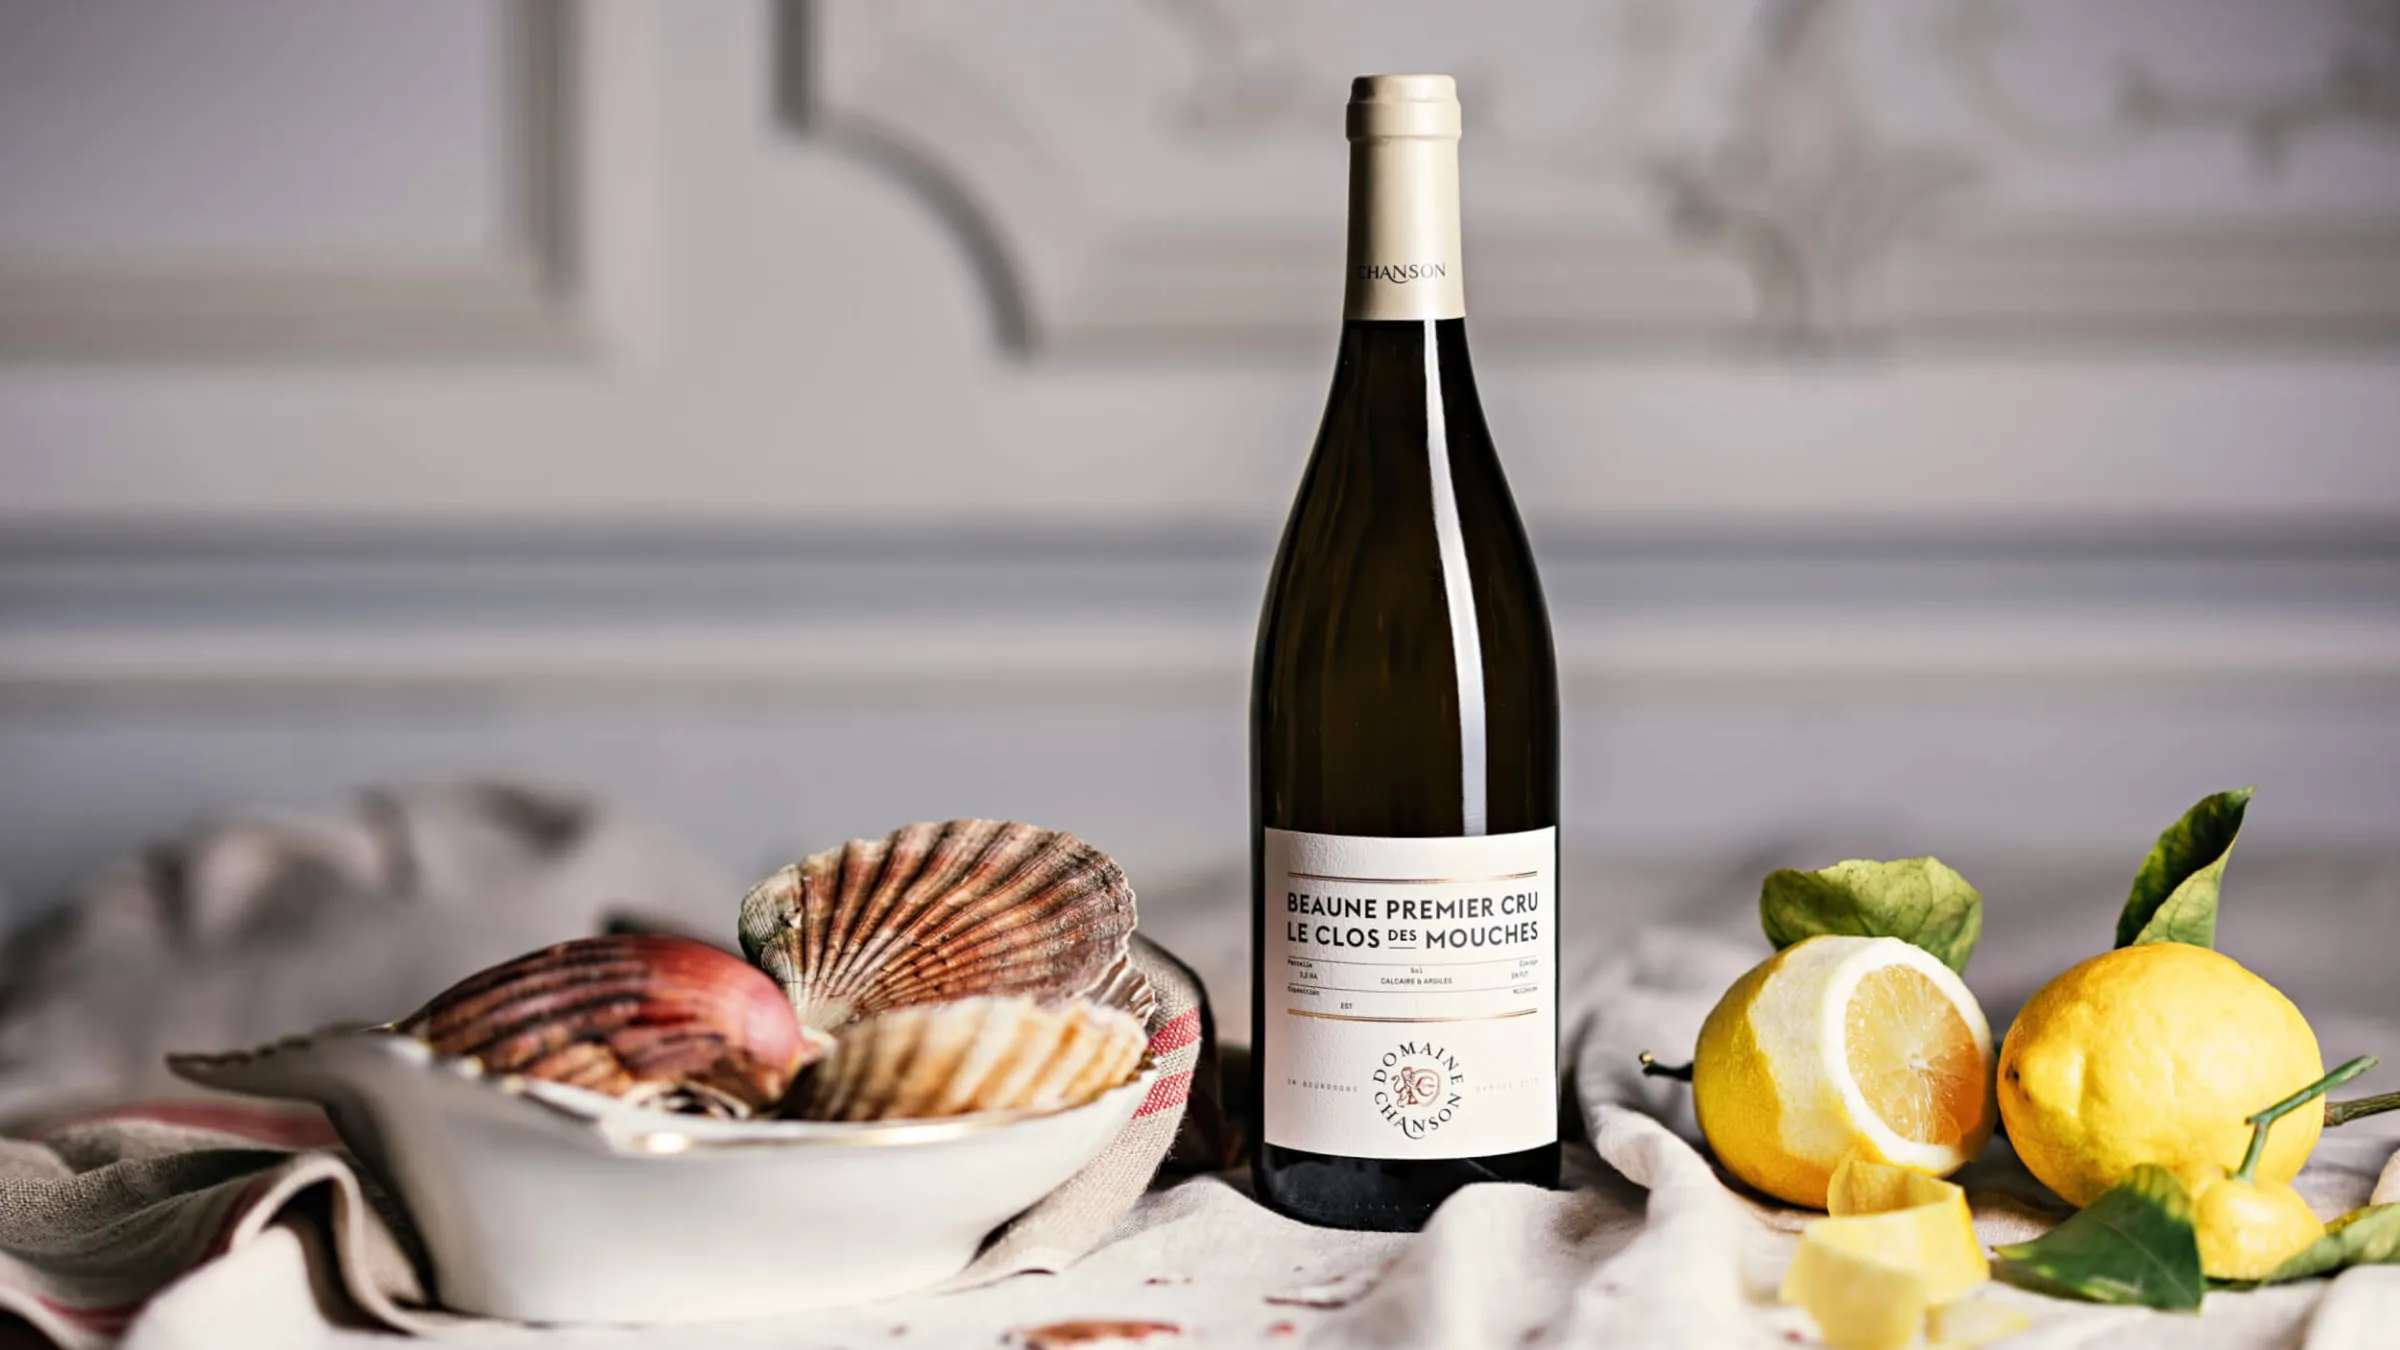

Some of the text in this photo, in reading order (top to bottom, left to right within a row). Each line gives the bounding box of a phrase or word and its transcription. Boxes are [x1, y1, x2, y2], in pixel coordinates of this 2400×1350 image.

[1357, 263, 1446, 284] CHANSON
[1287, 891, 1538, 920] BEAUNE PREMIER CRU
[1287, 921, 1538, 949] LE CLOS DES MOUCHES
[1373, 1041, 1464, 1085] DOMAINE
[1374, 1091, 1462, 1140] CHANSON
